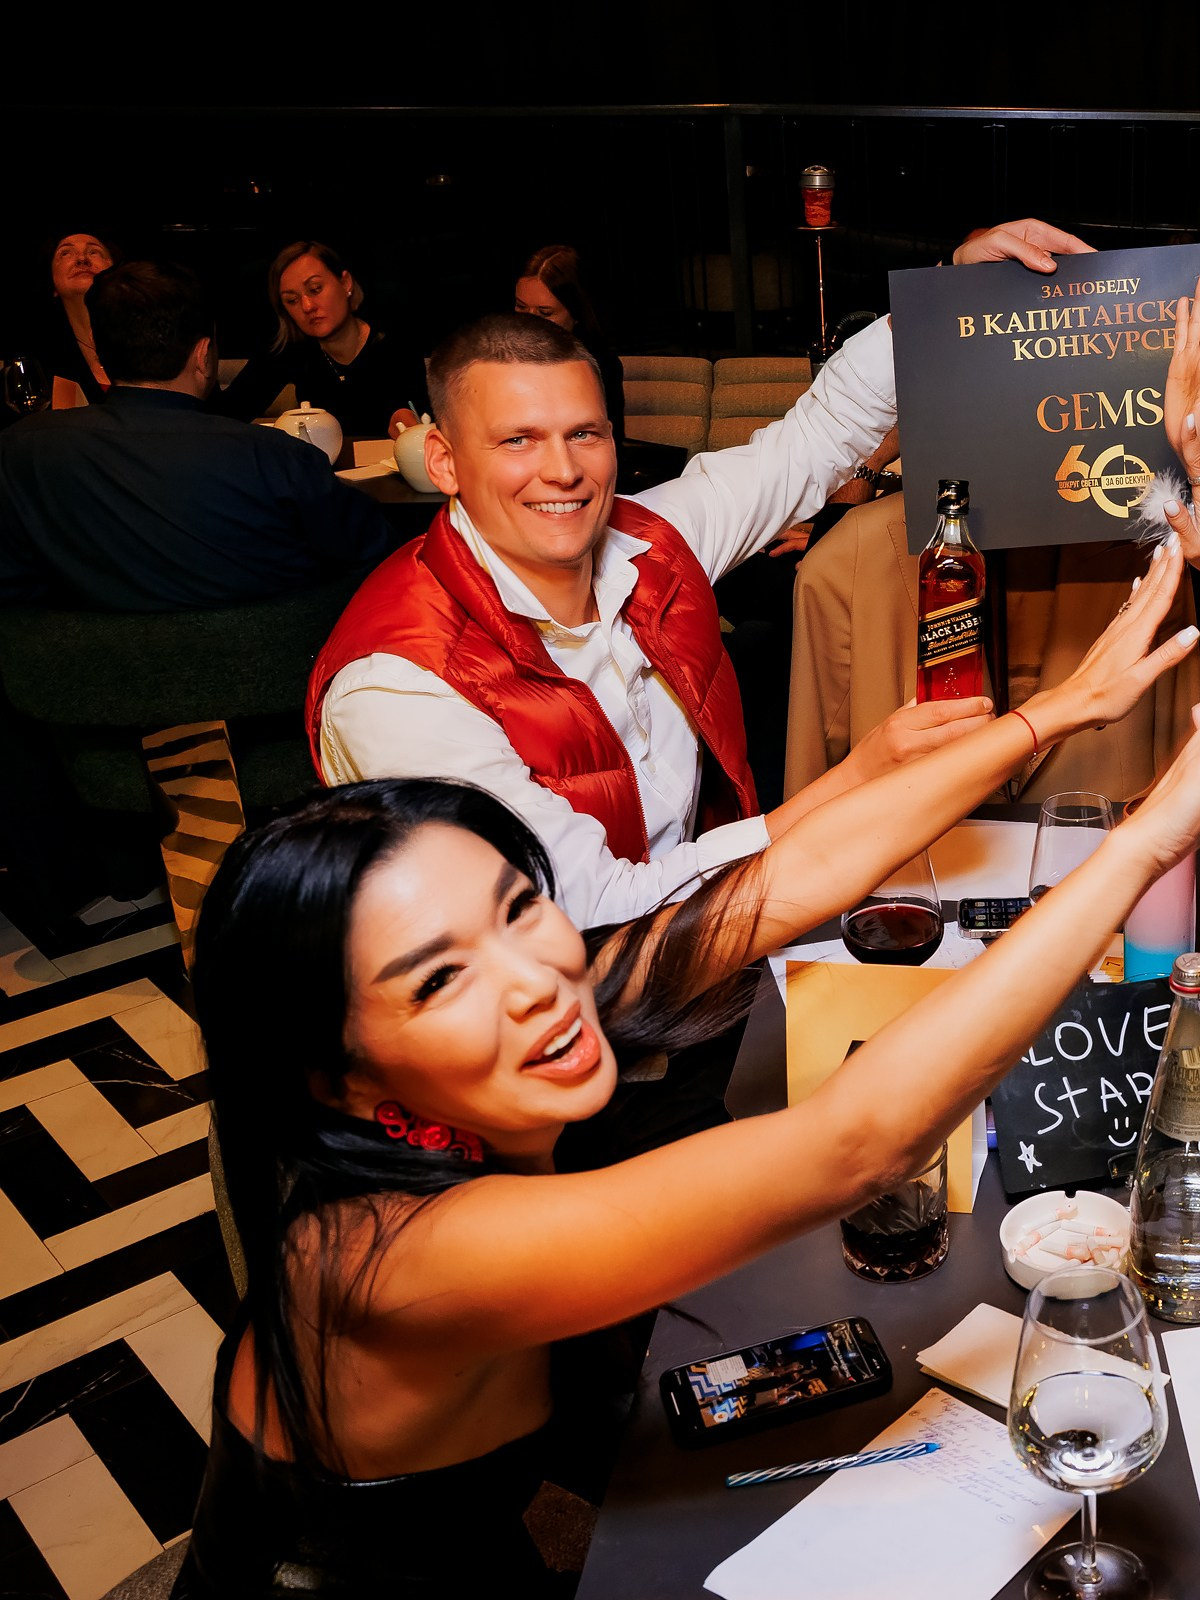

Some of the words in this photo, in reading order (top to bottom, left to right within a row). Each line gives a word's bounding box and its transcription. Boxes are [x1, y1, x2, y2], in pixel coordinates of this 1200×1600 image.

[1041, 285, 1064, 299] ЗА
[1068, 277, 1141, 297] ПОБЕДУ
[957, 316, 976, 338] В
[982, 298, 1196, 337] КАПИТАНСК
[1011, 327, 1177, 361] КОНКУРСЕ
[1036, 387, 1165, 433] GEMS
[1059, 480, 1080, 489] ВОКРУГ
[1081, 478, 1099, 488] СВЕТА
[1105, 477, 1115, 486] ЗА
[1115, 477, 1124, 486] 60
[920, 626, 953, 643] BLACK
[953, 615, 982, 633] LABEL
[1029, 1004, 1171, 1067] LOVE
